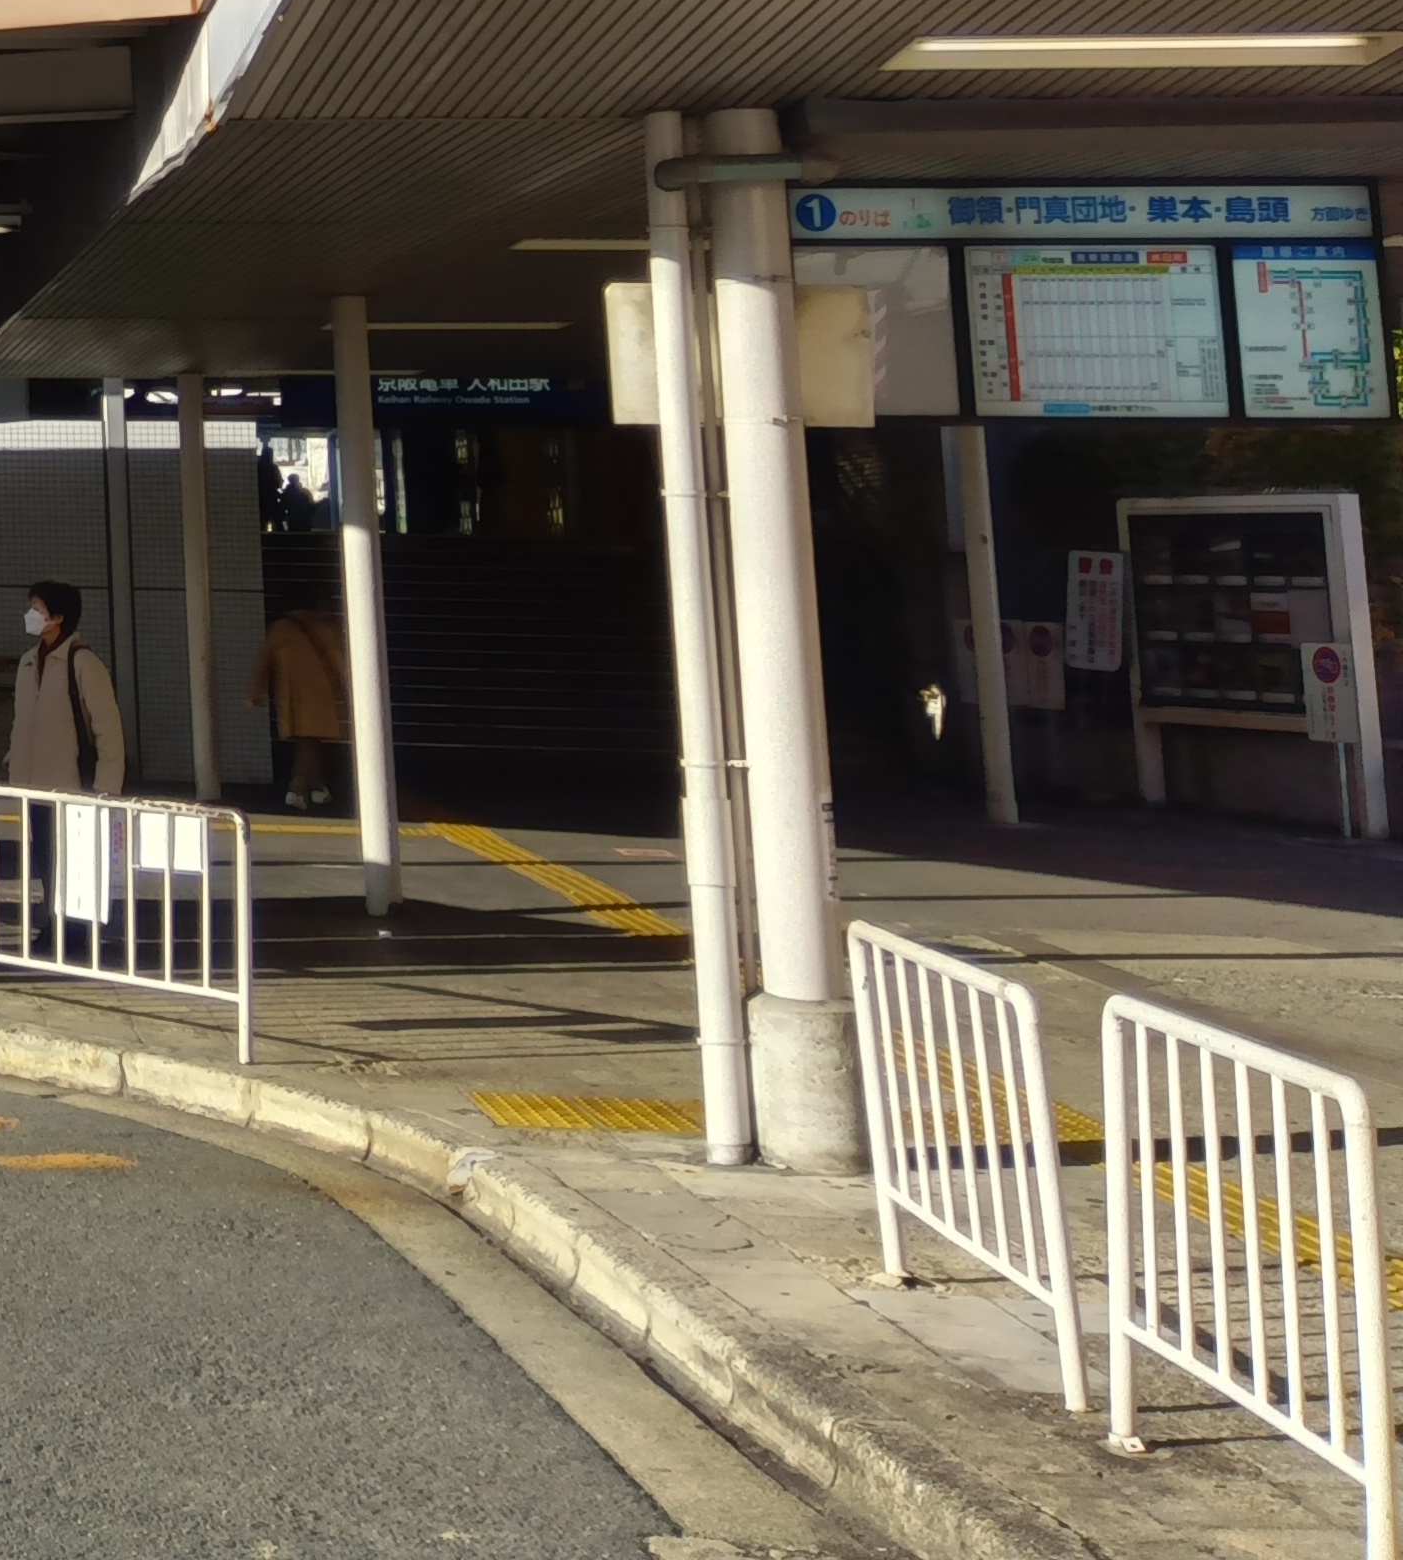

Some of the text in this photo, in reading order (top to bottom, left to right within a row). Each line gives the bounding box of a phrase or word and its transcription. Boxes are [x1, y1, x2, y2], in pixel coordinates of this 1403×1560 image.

[839, 209, 891, 227] のりば
[378, 395, 411, 405] Keihan
[413, 395, 452, 406] Railway
[493, 395, 530, 405] Station
